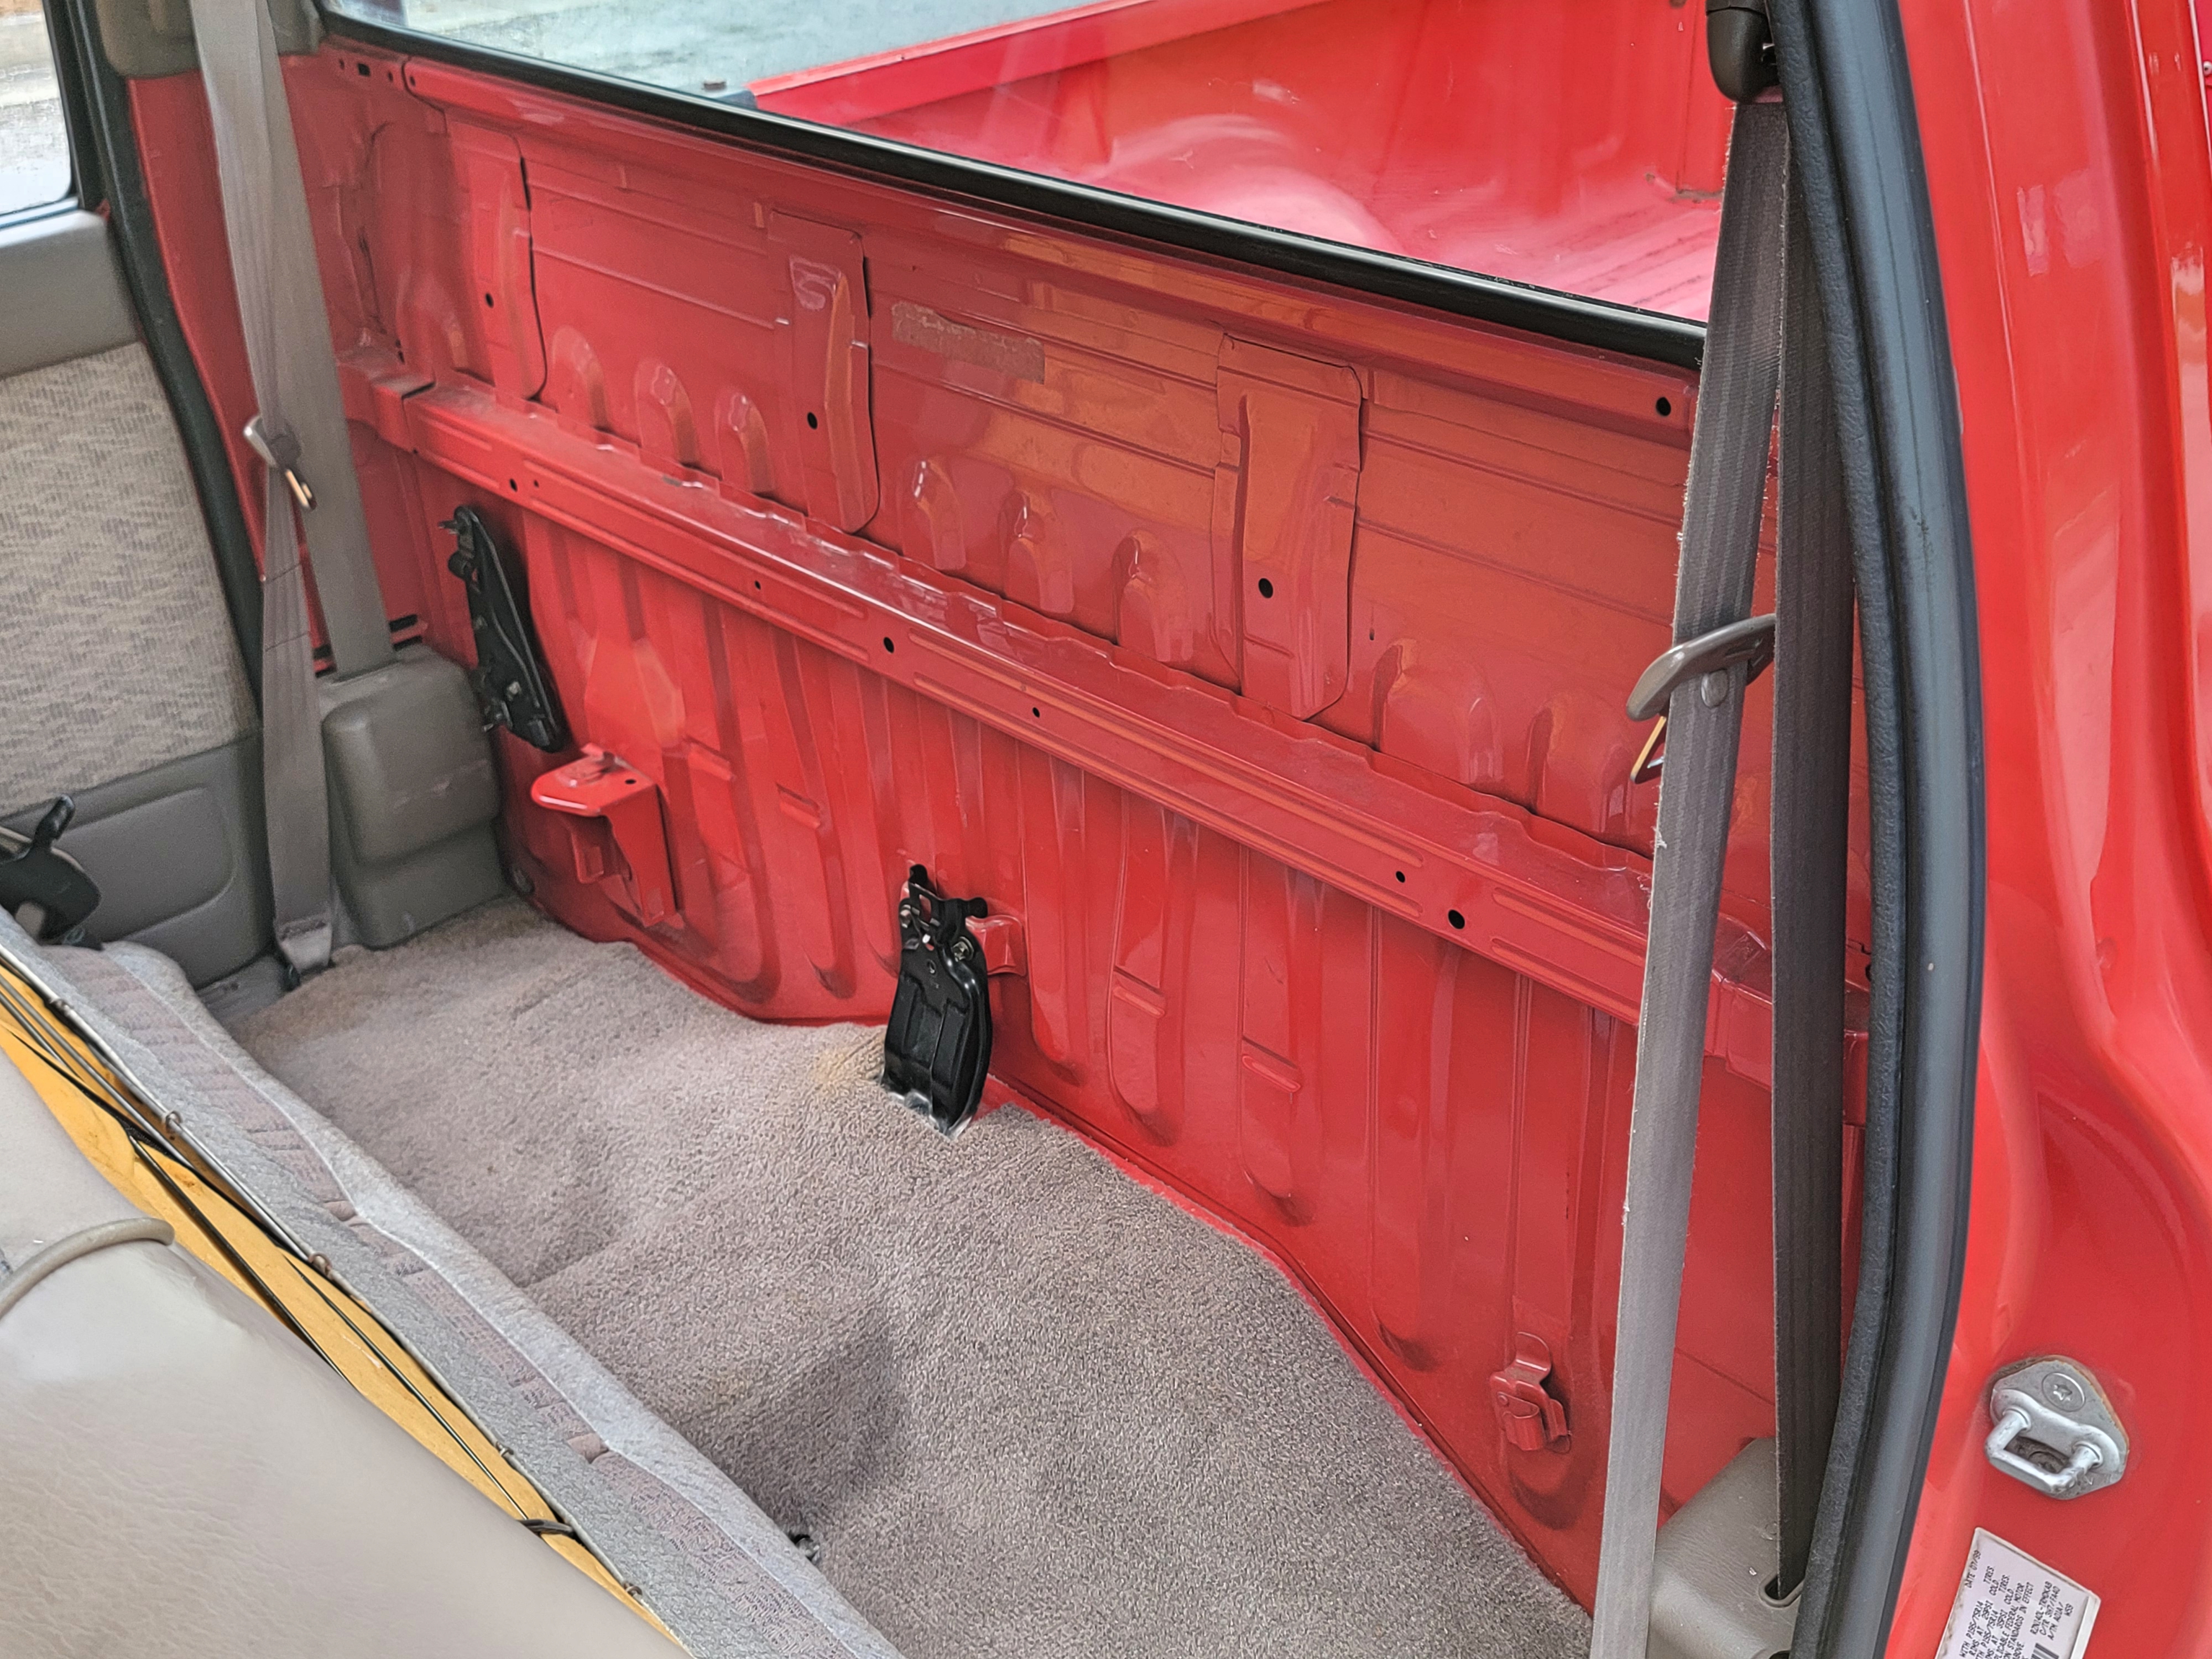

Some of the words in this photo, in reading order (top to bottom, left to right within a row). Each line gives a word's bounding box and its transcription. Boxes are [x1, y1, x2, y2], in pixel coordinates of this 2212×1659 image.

[2022, 1582, 2033, 1604] EFFECT
[2005, 1604, 2018, 1630] FEDERAL
[2013, 1583, 2025, 1603] MOTOR
[2018, 1605, 2027, 1613] IN
[1975, 1625, 1984, 1636] AT
[2007, 1614, 2024, 1650] STANDARDS
[1991, 1635, 1999, 1645] AT
[1959, 1641, 1970, 1658] WITH
